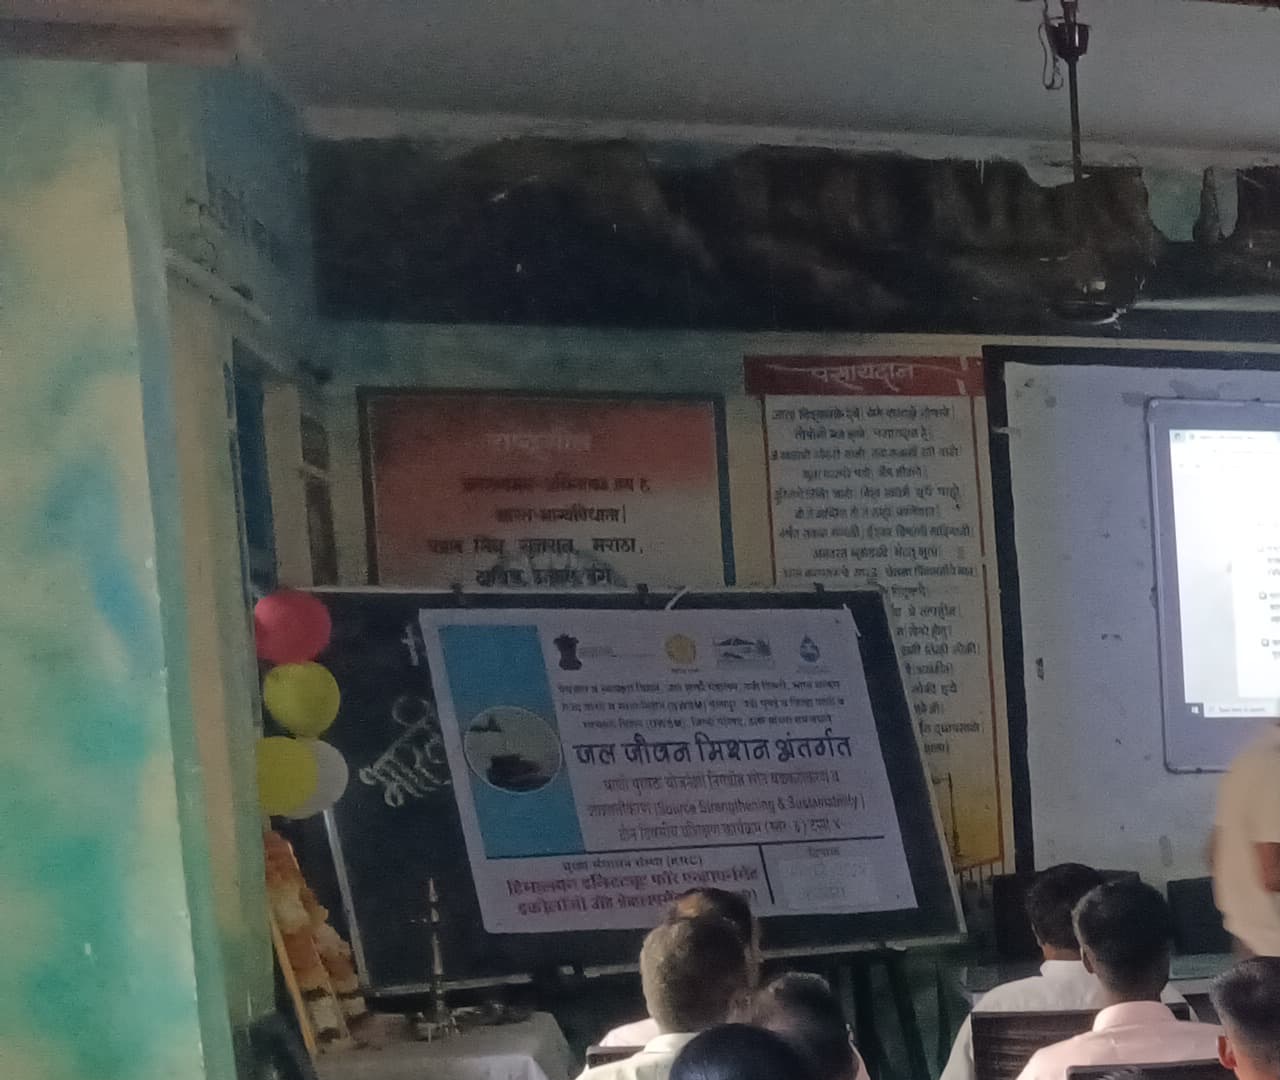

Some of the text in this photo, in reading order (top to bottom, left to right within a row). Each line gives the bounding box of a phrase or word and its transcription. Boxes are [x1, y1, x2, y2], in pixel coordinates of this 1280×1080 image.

[572, 728, 852, 765] जल जीवन मिशन अंतर्गत
